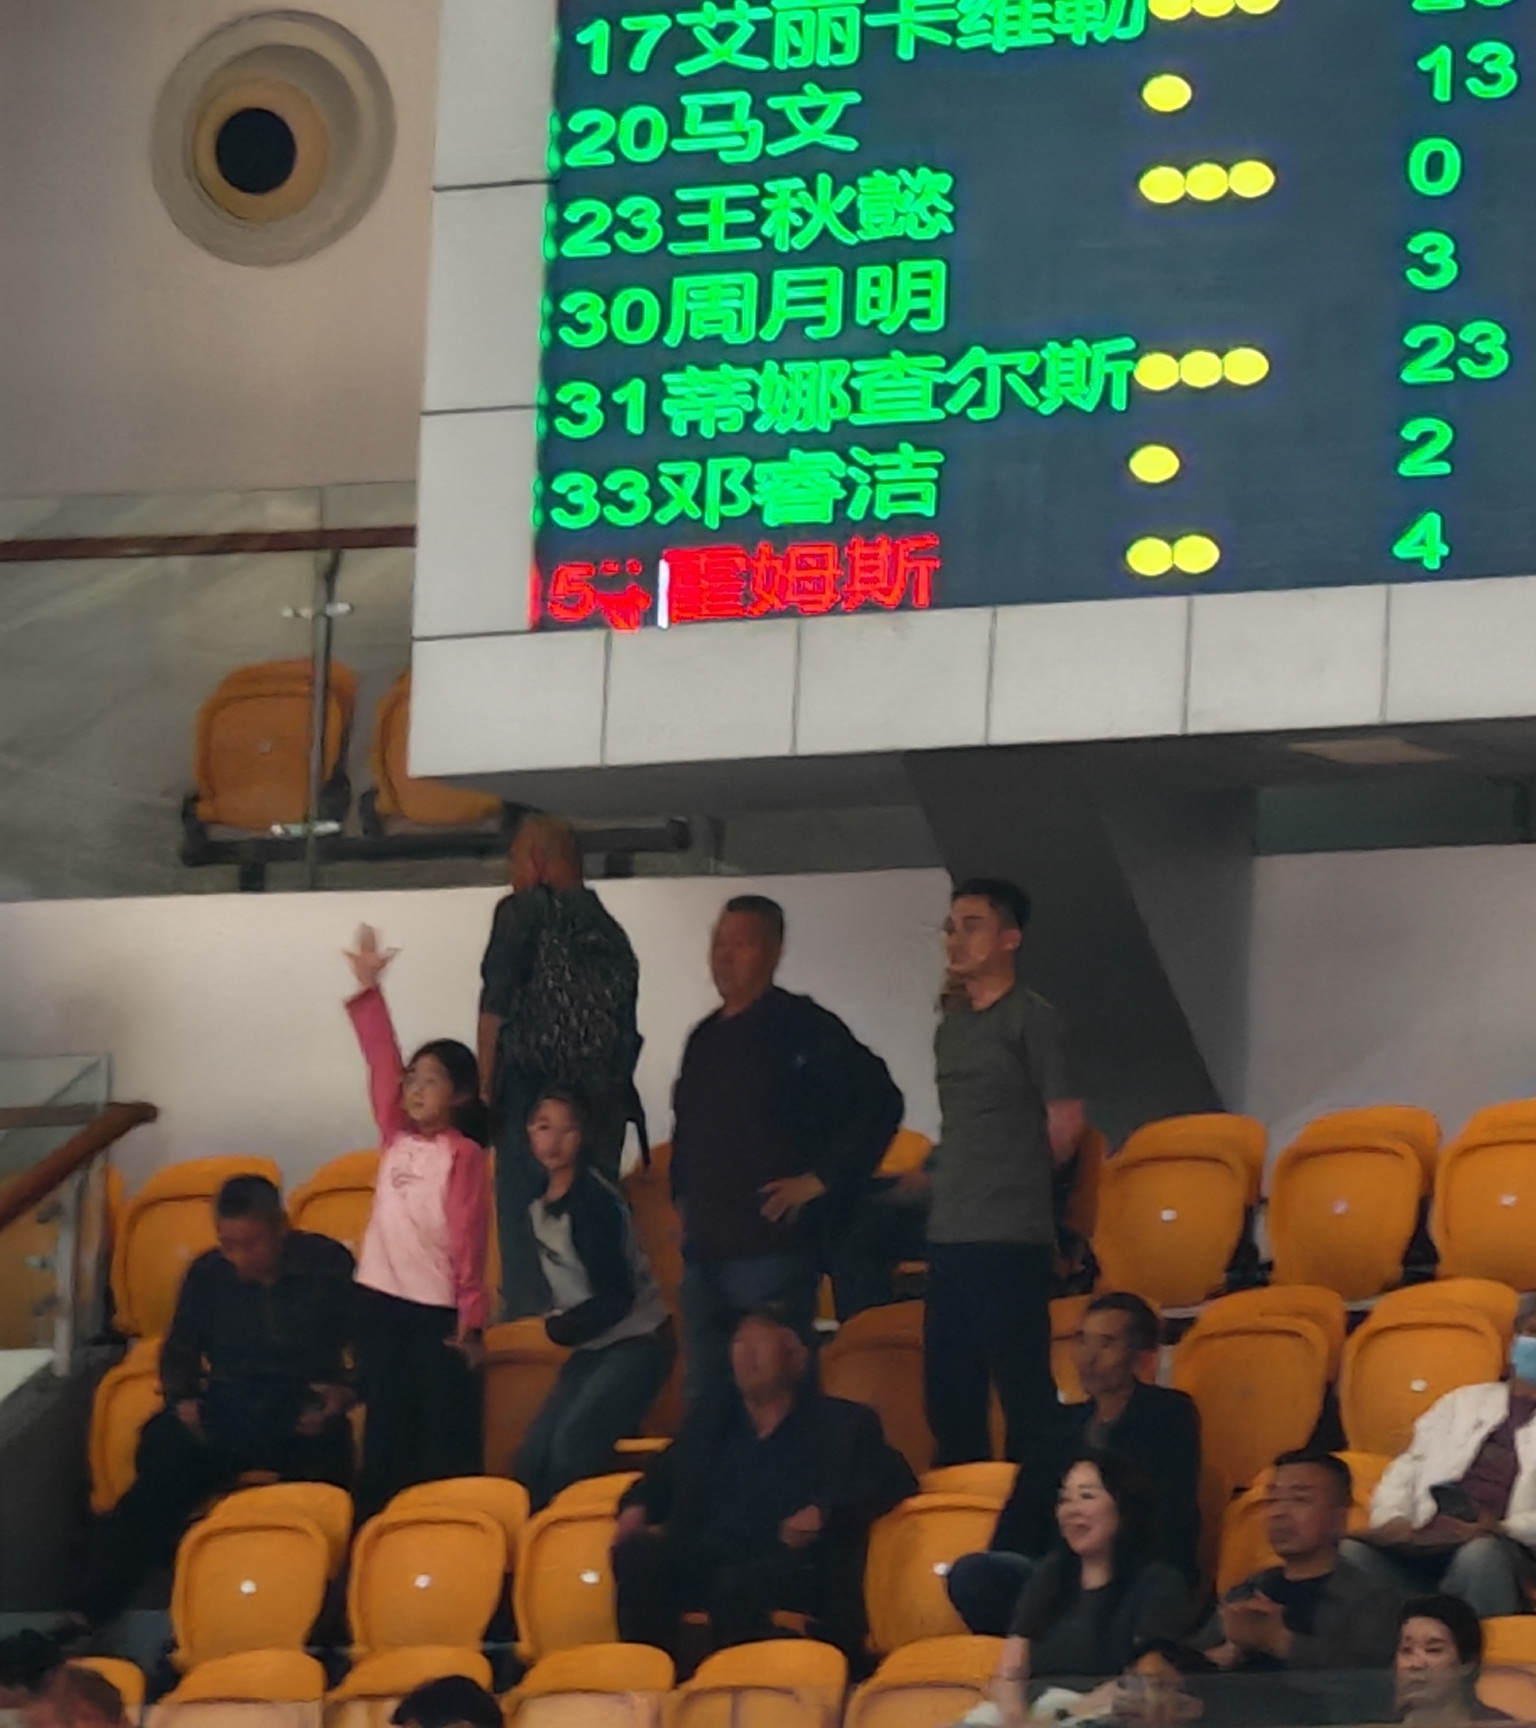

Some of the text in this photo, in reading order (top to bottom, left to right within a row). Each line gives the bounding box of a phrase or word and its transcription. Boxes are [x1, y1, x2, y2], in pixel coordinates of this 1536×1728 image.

[1416, 40, 1519, 103] 13
[1407, 136, 1462, 197] 0
[1404, 230, 1459, 291] 3
[1399, 319, 1510, 385] 23
[1396, 416, 1454, 478] 2
[1391, 510, 1451, 571] 4
